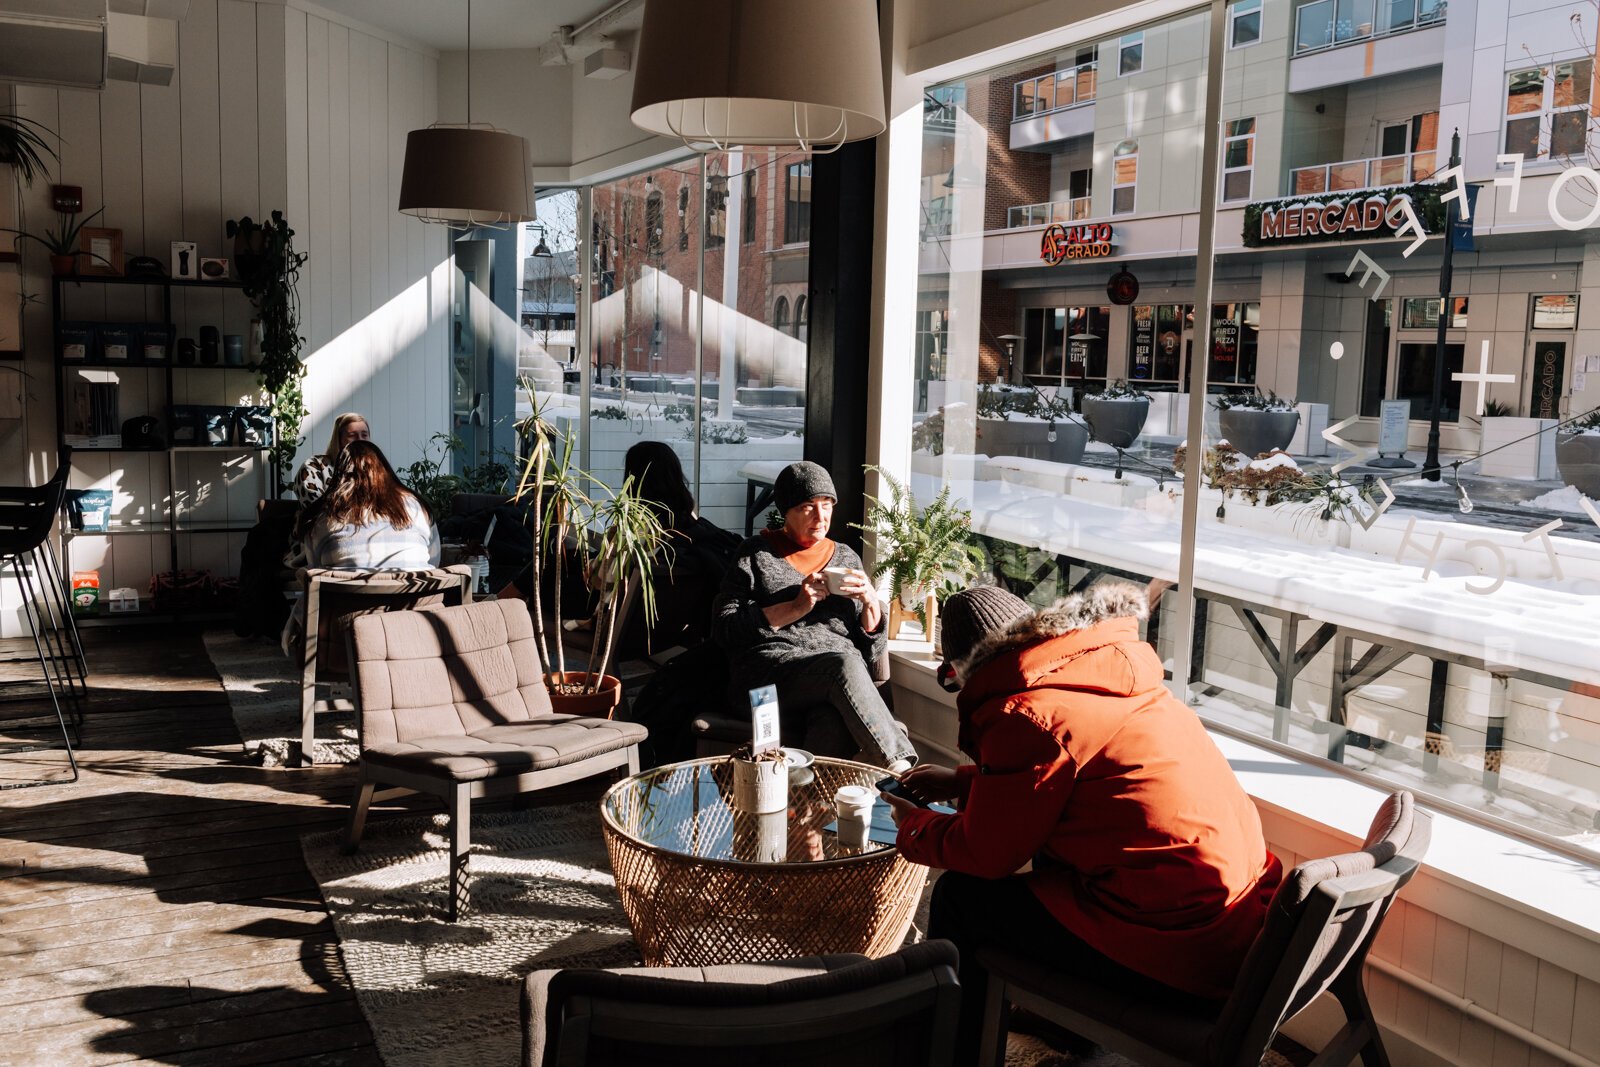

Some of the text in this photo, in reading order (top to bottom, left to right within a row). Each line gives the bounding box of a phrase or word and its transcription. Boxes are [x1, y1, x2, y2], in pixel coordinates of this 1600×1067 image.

[1261, 197, 1411, 239] MERCADO
[1068, 223, 1112, 244] ALTO
[1066, 241, 1111, 259] GRADO
[1070, 353, 1083, 362] EATS
[1136, 345, 1149, 354] BEER
